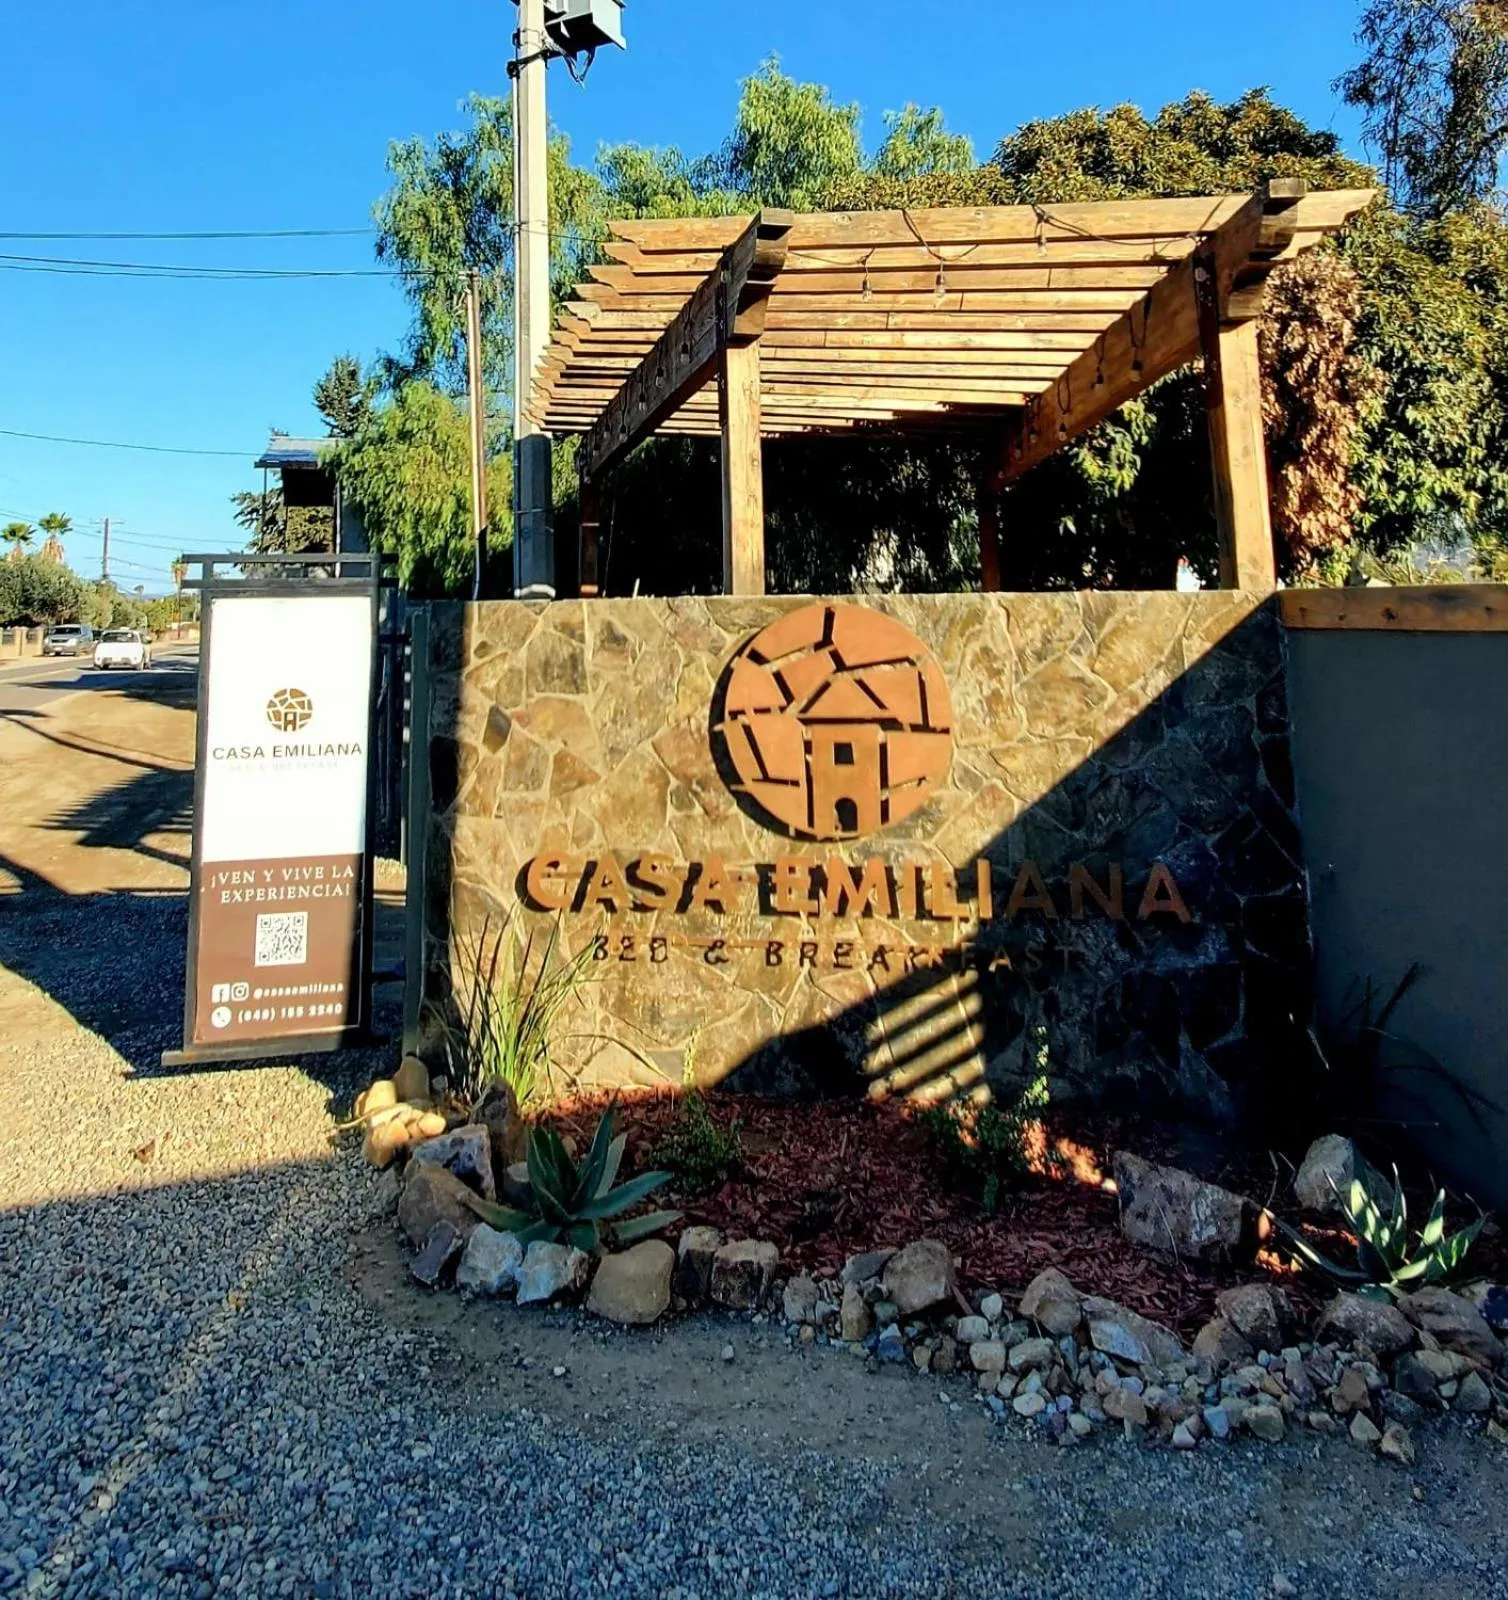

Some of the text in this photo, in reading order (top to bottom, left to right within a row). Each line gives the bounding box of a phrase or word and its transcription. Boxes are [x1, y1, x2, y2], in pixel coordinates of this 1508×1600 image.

[212, 742, 362, 761] CASA EMILIANA
[263, 869, 274, 882] Y
[282, 866, 324, 881] VIVE
[332, 864, 354, 879] LA
[221, 882, 350, 904] EXPERIENCIA!
[520, 852, 1194, 924] CASA EMILIANA
[704, 938, 729, 965] &
[765, 939, 1080, 975] BREAKFAST
